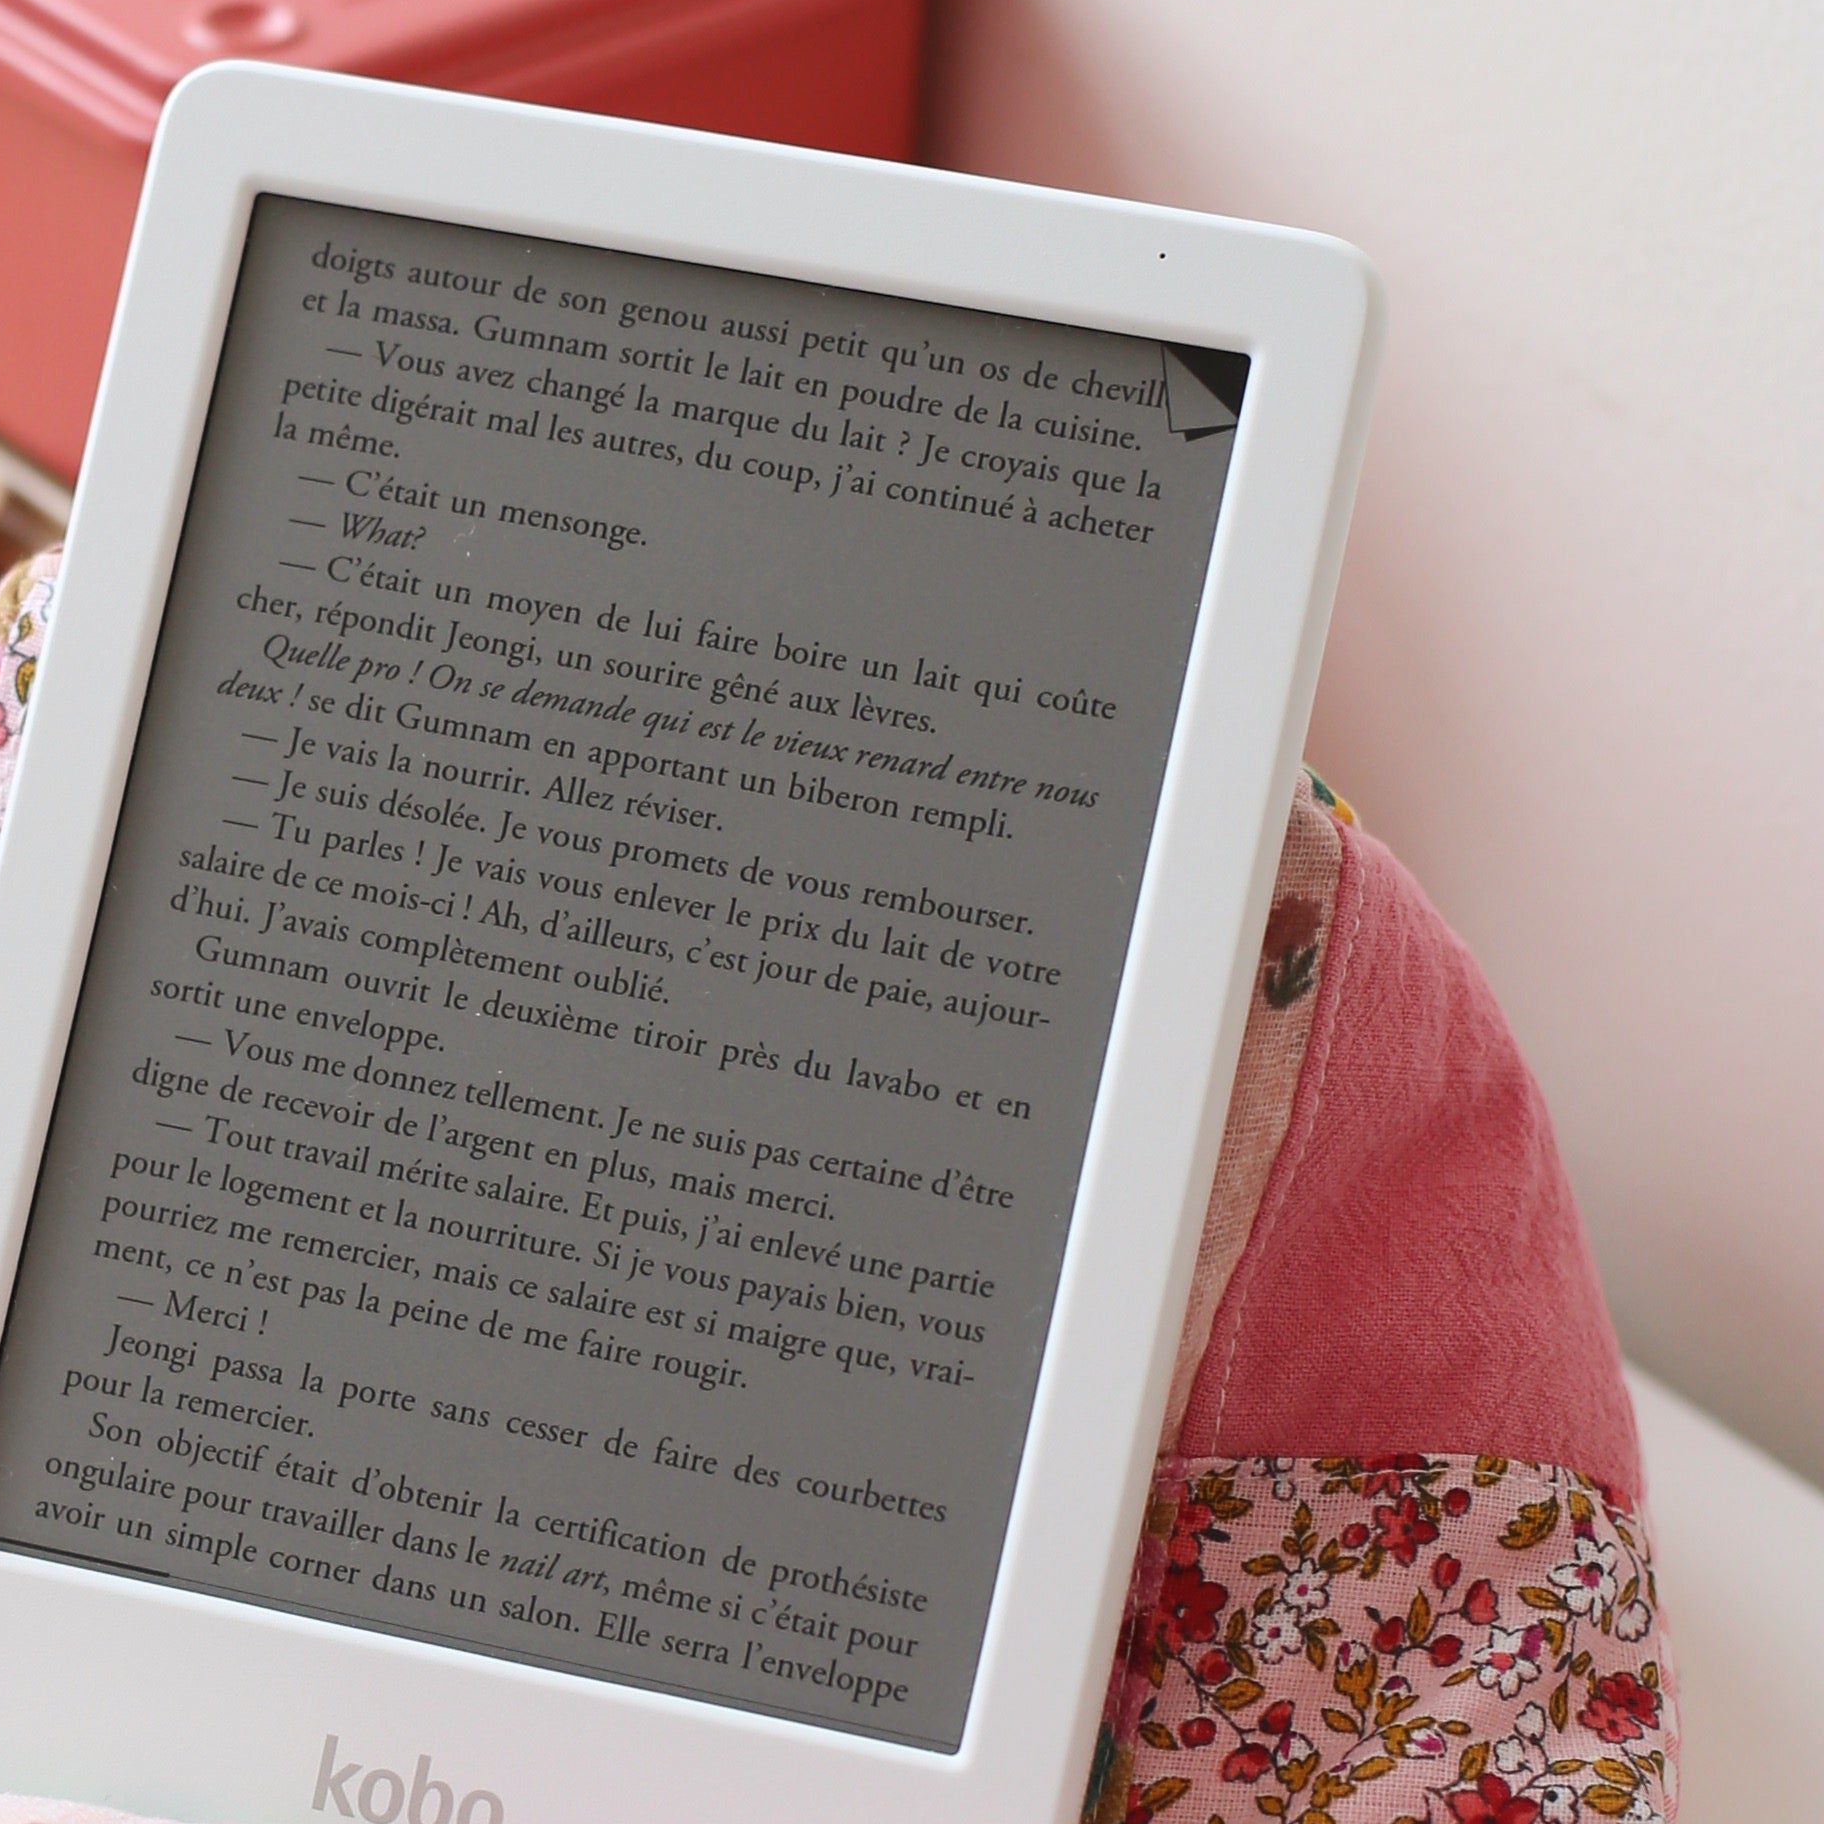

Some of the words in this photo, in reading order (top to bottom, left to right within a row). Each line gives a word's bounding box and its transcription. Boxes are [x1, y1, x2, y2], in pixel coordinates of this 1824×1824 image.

[301, 293, 328, 313] et
[335, 288, 361, 320] la
[371, 305, 459, 336] massa.
[473, 314, 608, 361] Gumnam
[618, 347, 695, 375] sortit
[703, 350, 730, 381] le
[738, 356, 785, 390] lait
[794, 376, 828, 398] en
[837, 383, 943, 417] poudre
[953, 393, 989, 425] de
[996, 399, 1023, 431] la
[1034, 414, 1141, 451] cuisine.
[310, 241, 396, 285] doigts
[406, 266, 502, 297] autour
[512, 274, 547, 305] de
[557, 291, 607, 315] son
[617, 301, 708, 332] genou
[720, 318, 790, 346] aussi
[798, 331, 869, 359] petit
[880, 340, 965, 376] qu’un
[979, 362, 1010, 383] os
[1022, 359, 1059, 391] de
[1071, 368, 1168, 409] chevill
[273, 410, 297, 441] la
[306, 422, 400, 459] même.
[280, 377, 362, 407] petite
[370, 383, 478, 428] digérait
[485, 409, 540, 438] mal
[546, 412, 585, 446] les
[591, 431, 683, 467] autres,
[694, 439, 732, 471] du
[742, 457, 821, 494] coup,
[828, 462, 877, 499] j’ai
[885, 482, 1015, 520] continué
[1021, 496, 1038, 524] à
[1047, 504, 1155, 544] acheter
[345, 469, 441, 510] C’était
[450, 495, 486, 519] un
[497, 504, 647, 552] mensonge.
[341, 510, 427, 551] What?
[236, 583, 302, 623] cher,
[313, 600, 437, 644] répondit
[440, 619, 542, 668] Jeongi,
[556, 649, 592, 672] un
[602, 657, 703, 691] sourire
[709, 672, 780, 705] gêné
[788, 691, 841, 717] aux
[849, 691, 936, 734] lèvres.
[272, 768, 307, 803] Je
[314, 782, 369, 811] suis
[377, 787, 486, 833] désolée.
[492, 809, 527, 844] Je
[537, 825, 603, 854] vous
[608, 840, 729, 878] promets
[739, 855, 775, 887] de
[785, 872, 851, 901] vous
[860, 886, 1033, 936] rembourser.
[282, 725, 317, 760] Je
[326, 739, 379, 768] vais
[386, 742, 411, 774] la
[421, 760, 530, 797] nourrir.
[541, 775, 615, 812] Allez
[623, 791, 723, 832] réviser.
[169, 883, 249, 924] d’hui.
[257, 900, 350, 943] J’avais
[359, 929, 564, 984] complètement
[573, 965, 669, 1005] oublié.
[195, 934, 328, 985] Gumnam
[343, 971, 431, 1004] ouvrit
[442, 979, 469, 1011] le
[481, 988, 619, 1040] deuxième
[633, 1020, 708, 1057] tiroir
[717, 1040, 780, 1072] près
[793, 1048, 831, 1082] du
[845, 1056, 941, 1102] lavabo
[954, 1089, 983, 1111] et
[996, 1097, 1031, 1120] en
[131, 1056, 209, 1099] digne
[218, 1073, 253, 1105] de
[261, 1091, 375, 1129] recevoir
[383, 1106, 418, 1137] de
[426, 1113, 536, 1161] l’argent
[544, 1147, 578, 1170] en
[586, 1148, 656, 1189] plus,
[669, 1171, 737, 1201] mais
[745, 1187, 835, 1221] merci.
[99, 1195, 219, 1235] pourriez
[227, 1220, 272, 1245] me
[280, 1231, 420, 1280] remercier,
[431, 1262, 499, 1292] mais
[508, 1278, 538, 1299] ce
[546, 1280, 637, 1319] salaire
[645, 1306, 686, 1330] est
[693, 1309, 718, 1337] si
[726, 1322, 827, 1362] maigre
[835, 1344, 896, 1377] que,
[910, 1358, 975, 1386] vrai-
[109, 1152, 180, 1181] pour
[186, 1156, 212, 1187] le
[218, 1162, 352, 1216] logement
[358, 1202, 388, 1223] et
[392, 1197, 418, 1230] la
[427, 1215, 581, 1263] nourriture.
[592, 1240, 622, 1271] Si
[625, 1247, 655, 1282] je
[663, 1262, 731, 1292] vous
[735, 1277, 827, 1312] payais
[835, 1286, 906, 1332] bien,
[918, 1313, 986, 1344] vous
[102, 1323, 198, 1374] Jeongi
[209, 1354, 283, 1386] passa
[298, 1361, 324, 1395] la
[336, 1380, 416, 1412] porte
[429, 1400, 491, 1428] sans
[505, 1416, 589, 1449] cesser
[603, 1426, 638, 1459] de
[652, 1435, 718, 1475] faire
[732, 1453, 781, 1488] des
[795, 1476, 948, 1523] courbettes
[87, 1411, 142, 1448] Son
[156, 1426, 270, 1472] objectif
[274, 1452, 339, 1489] était
[350, 1466, 483, 1519] d’obtenir
[493, 1494, 520, 1528] la
[534, 1514, 706, 1567] certification
[721, 1544, 757, 1577] de
[767, 1563, 928, 1613] prothésiste
[34, 1500, 106, 1530] avoir
[116, 1517, 153, 1542] un
[164, 1521, 258, 1567] simple
[268, 1550, 361, 1585] corner
[371, 1563, 437, 1602] dans
[449, 1588, 486, 1614] un
[498, 1594, 580, 1633] salon.
[594, 1610, 651, 1648] Elle
[660, 1634, 729, 1665] serra
[740, 1640, 909, 1708] l’enveloppe
